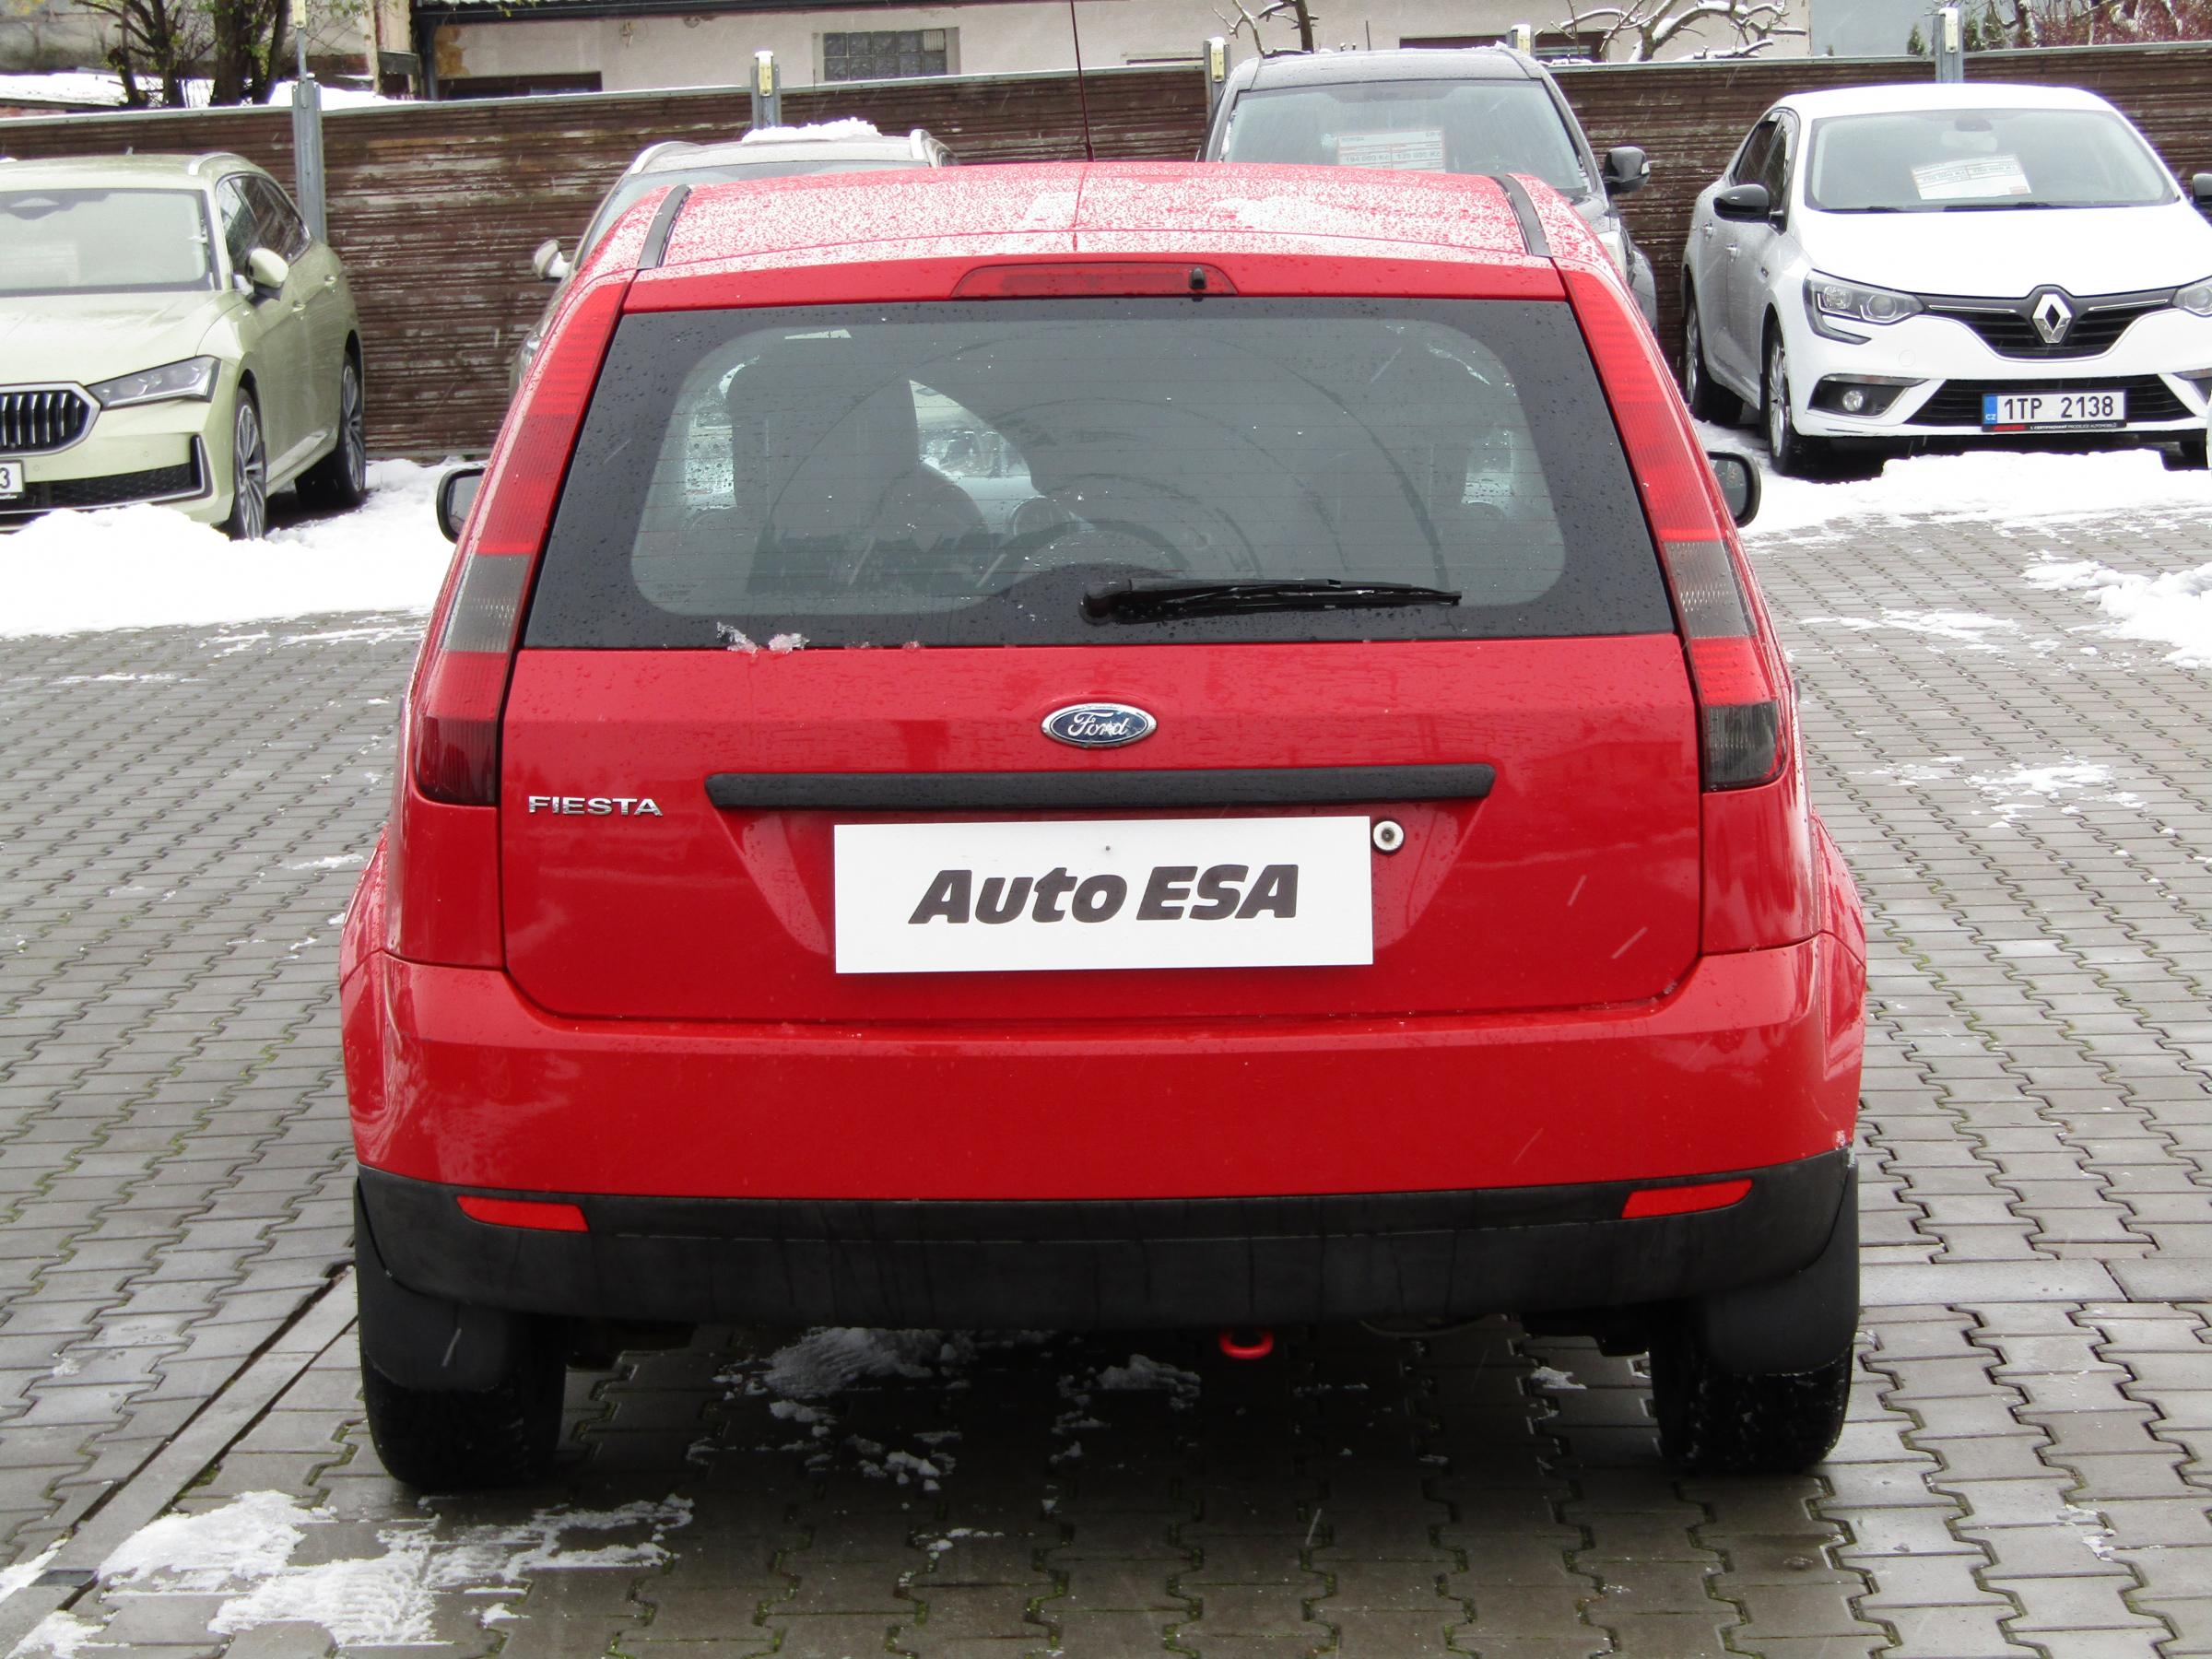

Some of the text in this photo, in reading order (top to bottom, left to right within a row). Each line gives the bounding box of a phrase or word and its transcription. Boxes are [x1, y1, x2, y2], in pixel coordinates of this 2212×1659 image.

[2004, 396, 2113, 419] 1TP 2138
[1067, 711, 1129, 736] Ford
[528, 795, 664, 817] FIESTA
[909, 865, 1298, 924] Auto ESA
